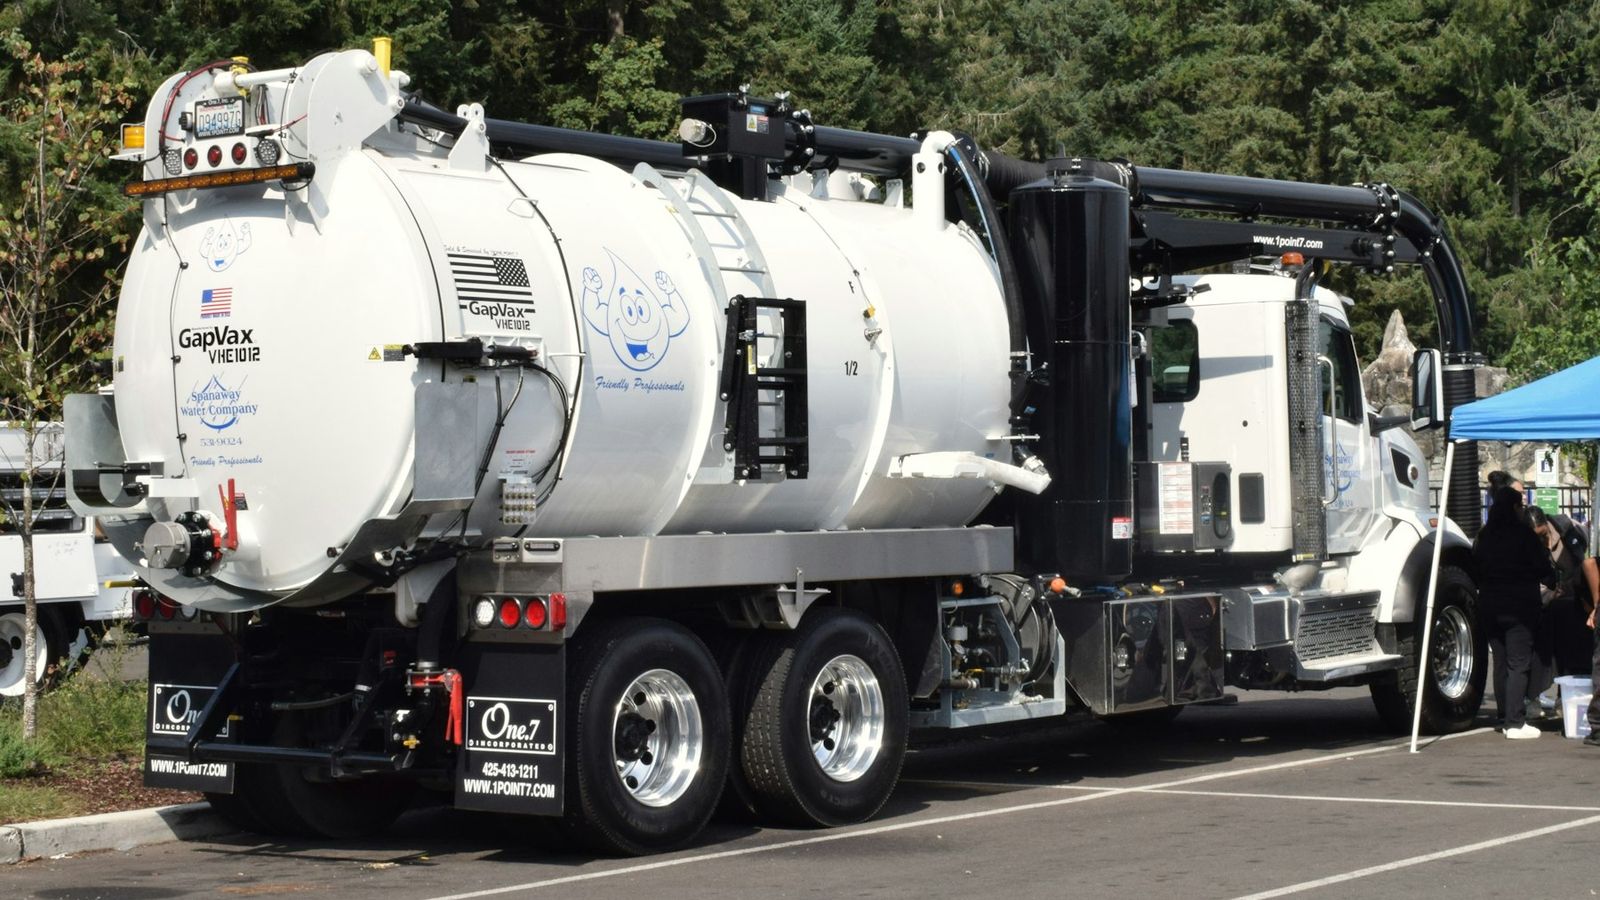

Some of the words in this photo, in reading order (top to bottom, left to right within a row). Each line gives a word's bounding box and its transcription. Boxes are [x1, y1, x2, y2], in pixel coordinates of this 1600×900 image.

[1253, 235, 1323, 249] www.1point7.com
[469, 301, 524, 319] GapVax
[495, 318, 531, 331] VHE1012
[179, 325, 253, 352] GapVax
[208, 347, 260, 364] VHE1012
[845, 360, 858, 376] 1/2
[595, 376, 630, 392] Friendly
[633, 377, 685, 394] Professionals
[191, 390, 242, 403] Spanaway
[180, 406, 206, 417] Water
[208, 403, 258, 416] Company
[190, 455, 216, 467] Friendly
[218, 454, 263, 467] Professionals
[482, 702, 541, 740] One.7
[476, 740, 545, 750] INCORPORATED
[482, 762, 539, 779] 425-413-1211
[464, 778, 555, 799] WWW.1POINT7.COM
